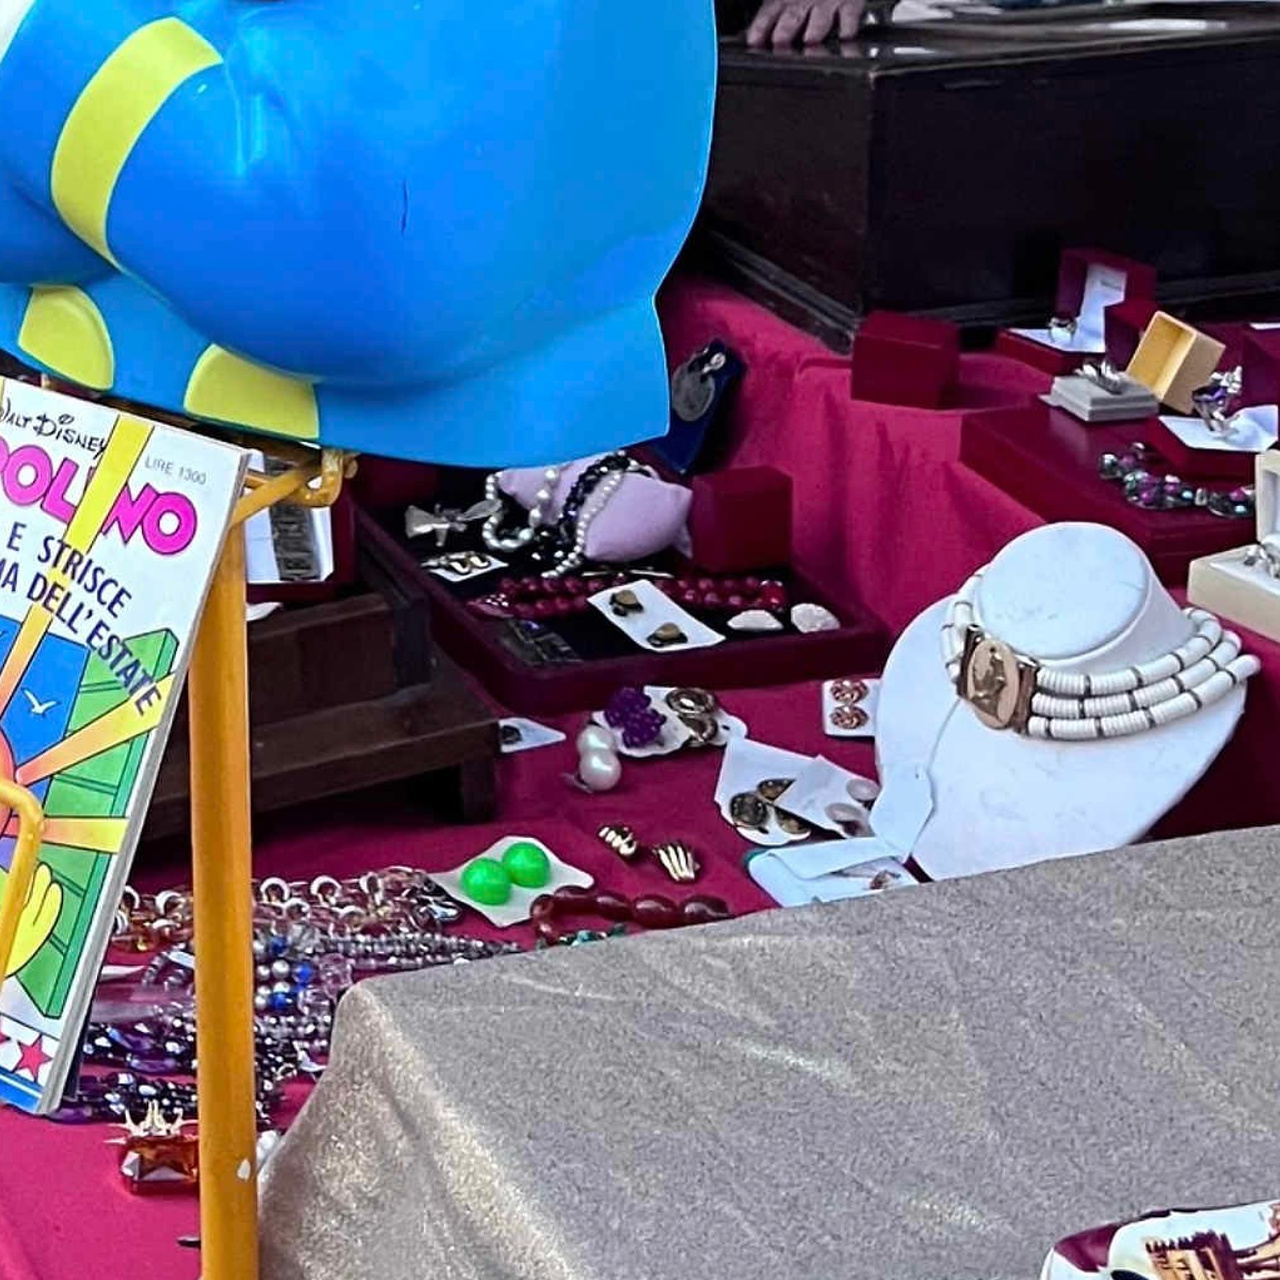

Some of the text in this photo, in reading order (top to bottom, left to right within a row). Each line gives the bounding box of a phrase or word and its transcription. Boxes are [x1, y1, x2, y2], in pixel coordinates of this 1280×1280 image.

[144, 454, 175, 476] LIRE
[6, 521, 28, 552] E
[37, 535, 133, 619] STRISCE
